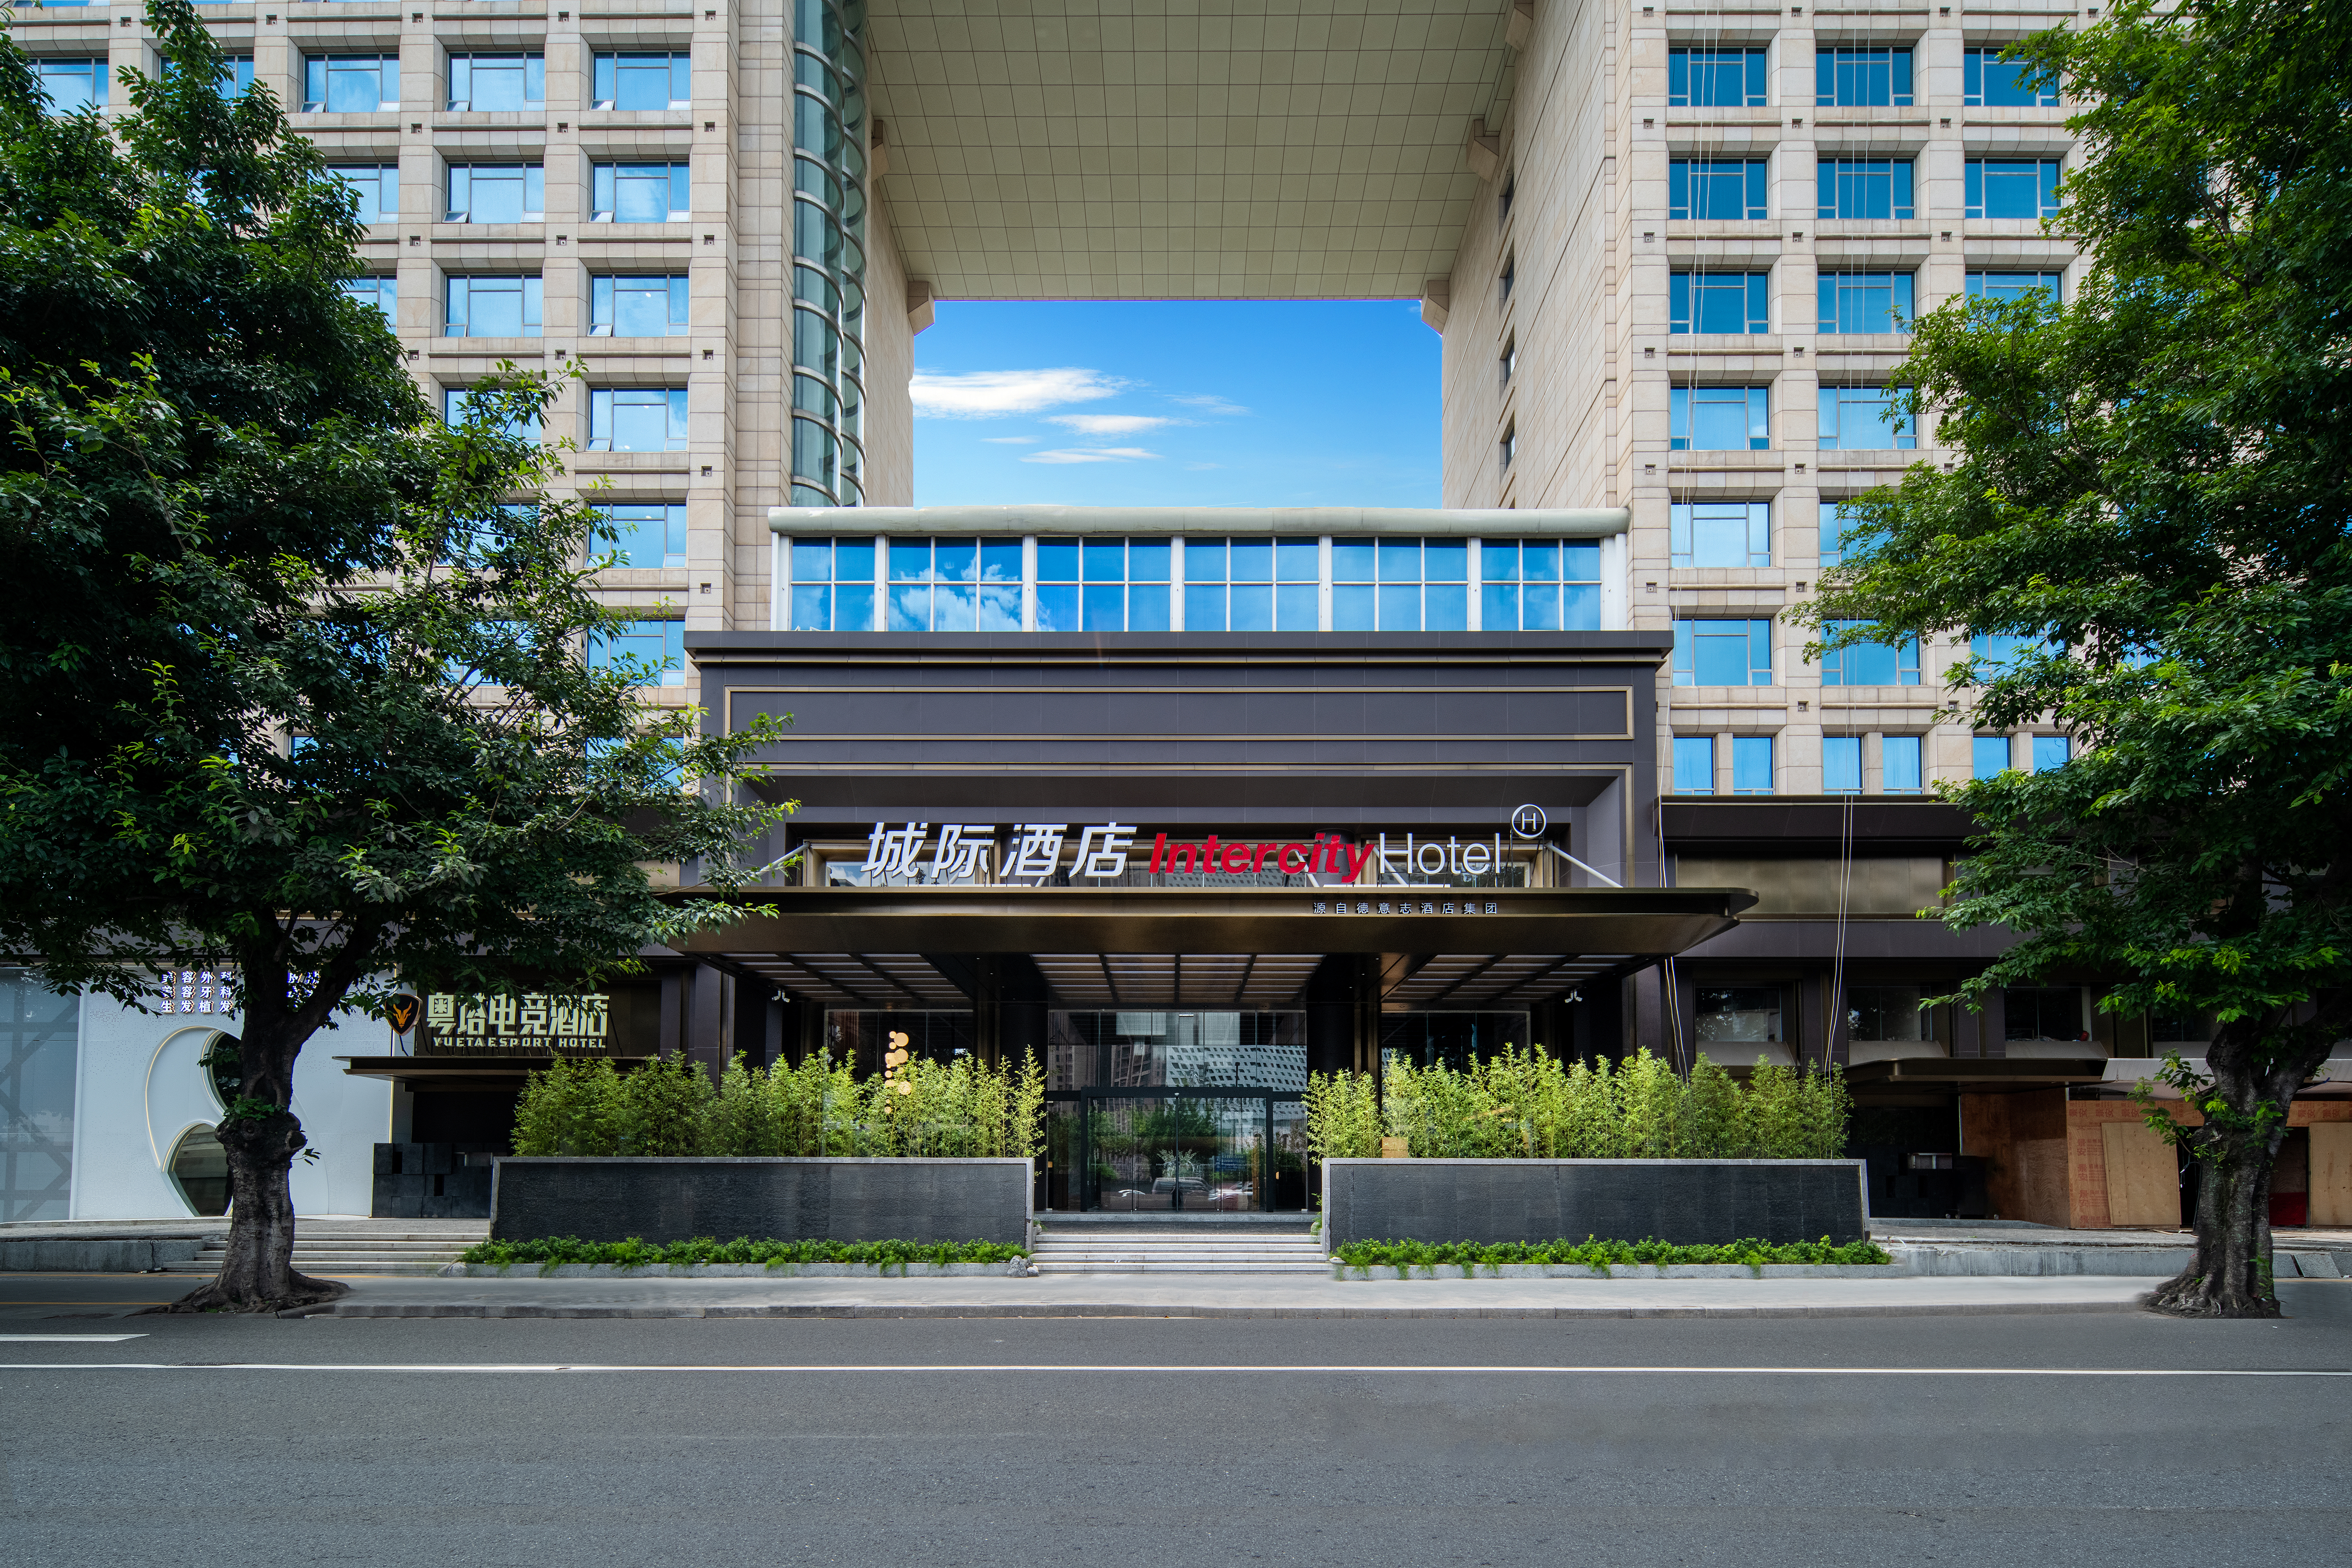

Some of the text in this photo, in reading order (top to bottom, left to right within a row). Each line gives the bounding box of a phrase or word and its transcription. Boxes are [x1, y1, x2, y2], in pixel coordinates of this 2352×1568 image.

[860, 822, 1137, 878] 城际酒店
[1313, 902, 1497, 914] 源自德意志酒店集团
[160, 1000, 231, 1013] 生发植发
[427, 992, 610, 1035] 粤塔电竞酒店
[558, 1038, 606, 1048] HOTEL
